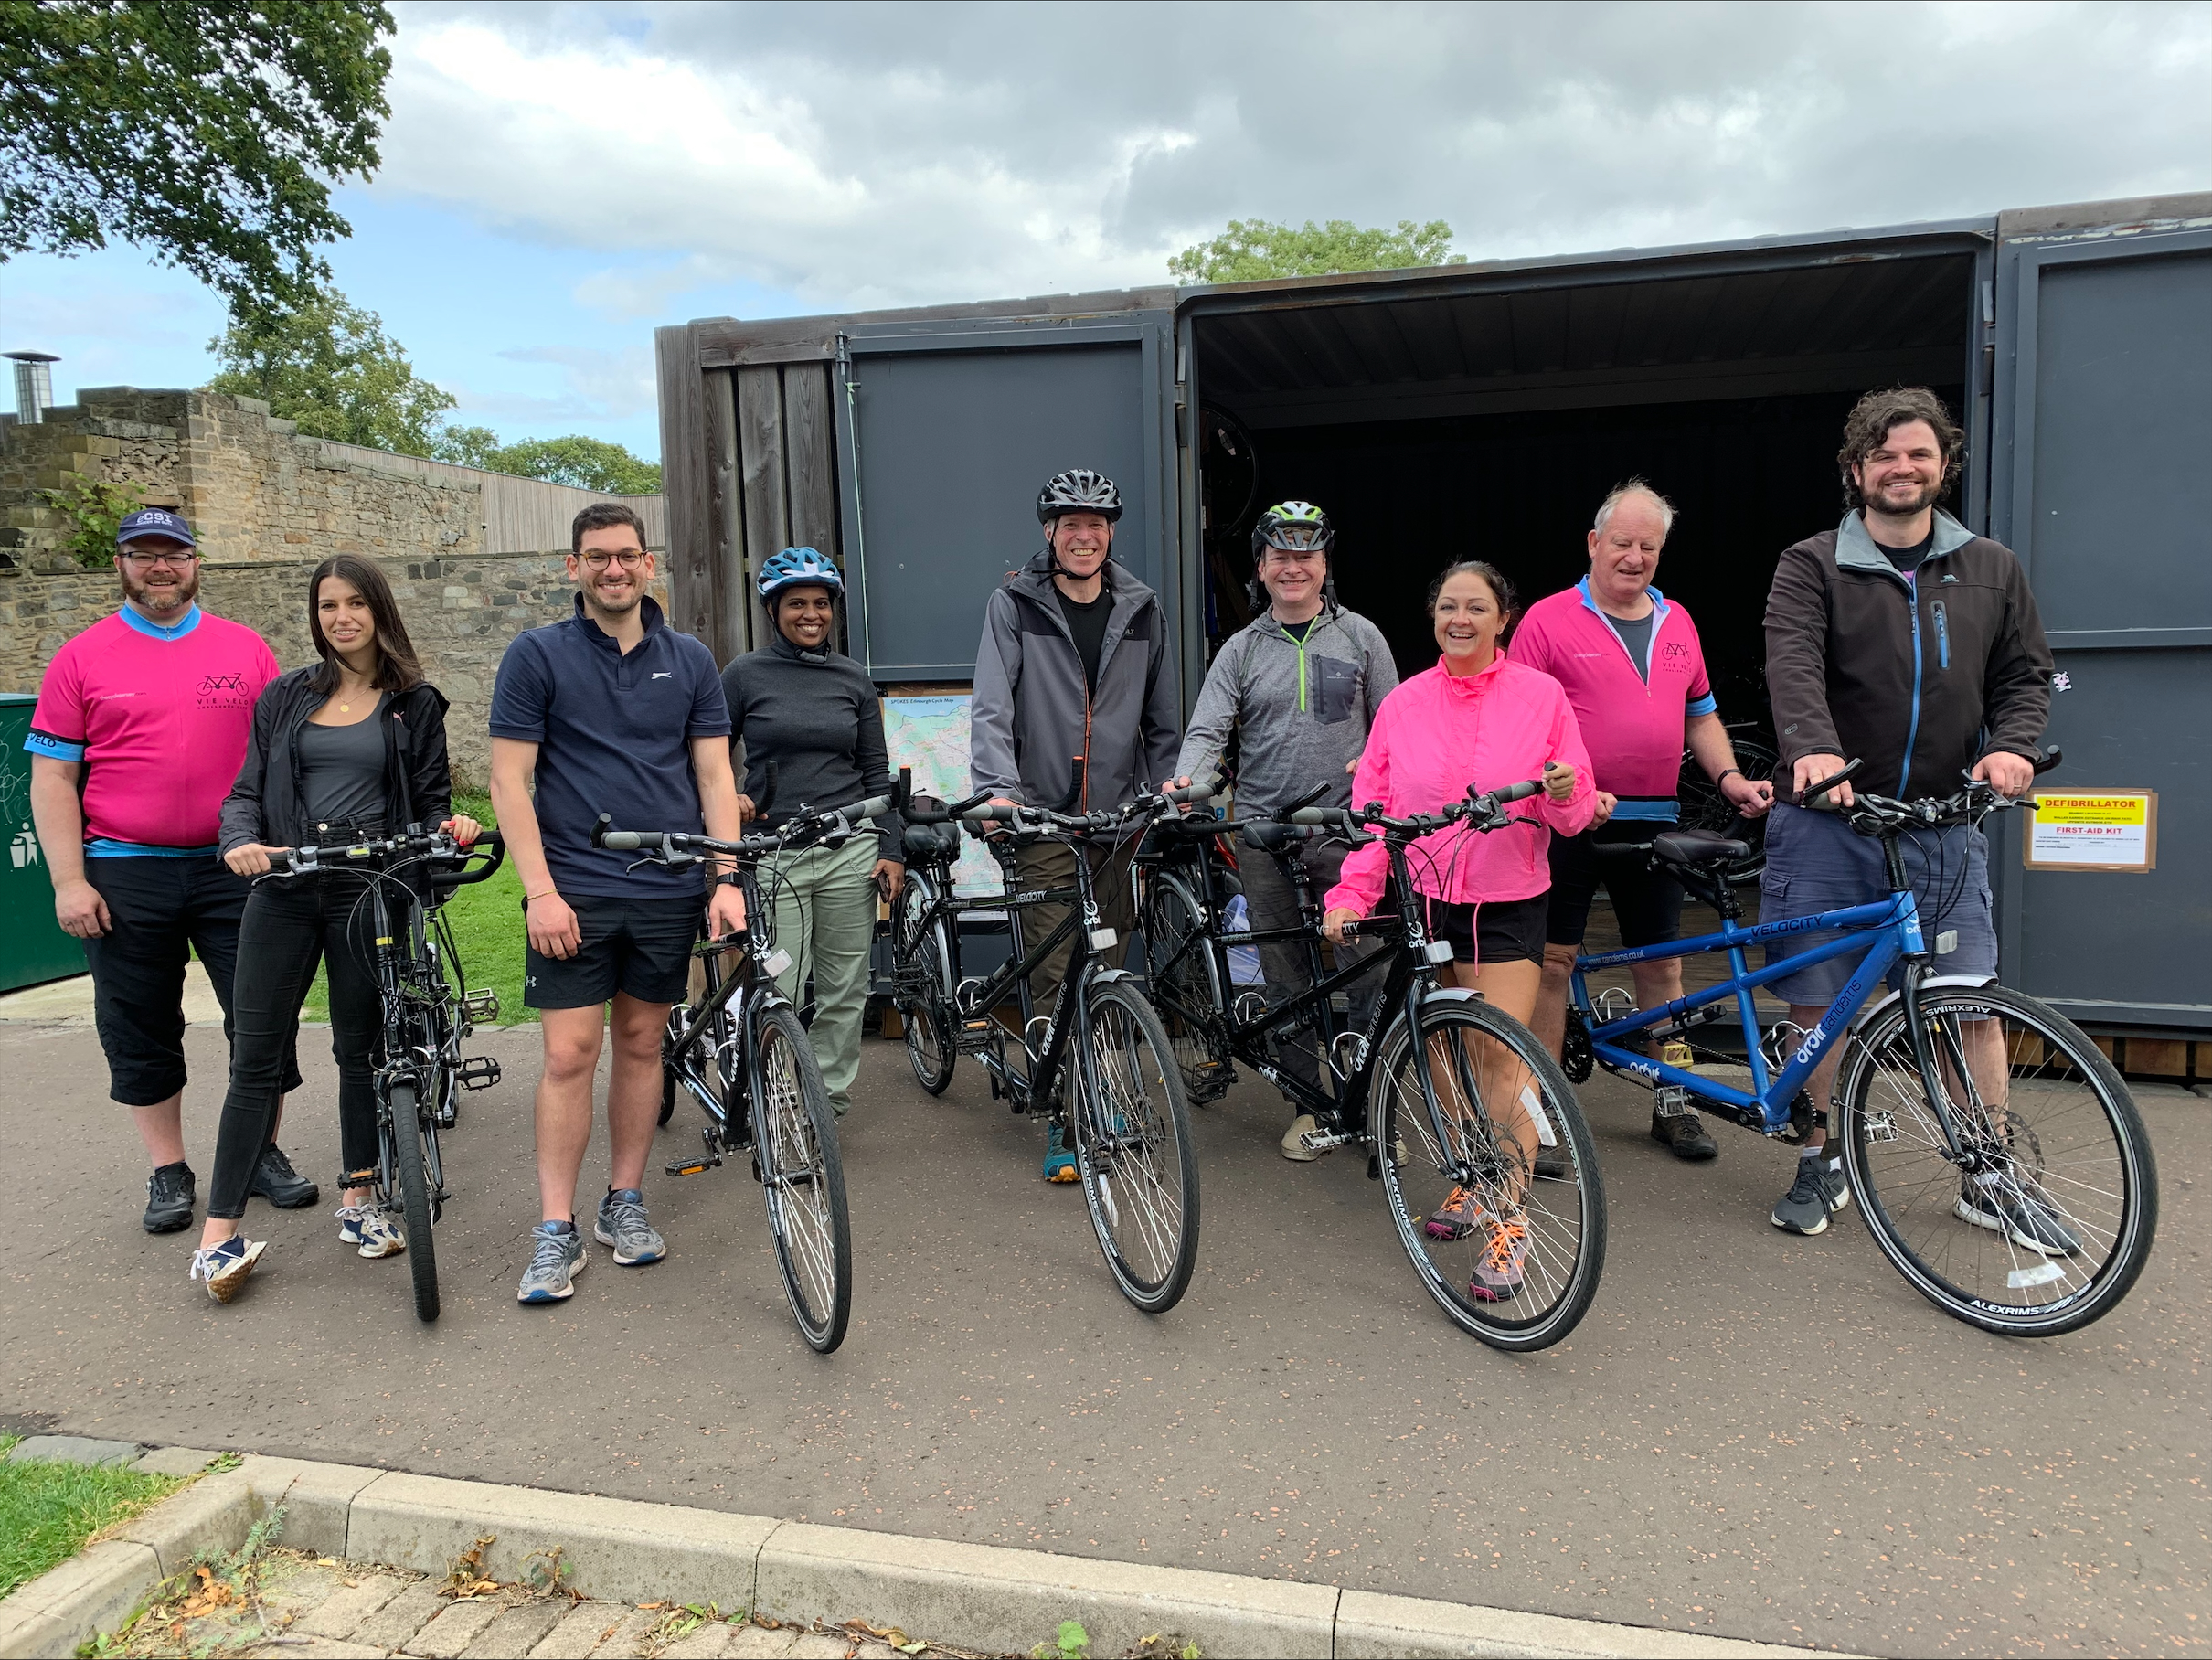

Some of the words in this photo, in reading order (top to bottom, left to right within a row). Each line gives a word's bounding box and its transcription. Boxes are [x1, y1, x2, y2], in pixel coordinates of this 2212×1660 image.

[225, 697, 249, 706] VELO
[2045, 799, 2136, 808] DEFIBRILLATOR
[1016, 890, 1048, 904] VELOCITY
[1749, 914, 1824, 938] VELOCITY
[1587, 949, 1646, 965] www.tandems.co.uk
[1821, 979, 1862, 1031] tandems
[1925, 1004, 1991, 1016] ALEXRIMS
[1630, 1061, 1660, 1082] orbit
[1081, 1144, 1099, 1210] ALEXRIMS
[1387, 1157, 1411, 1229] ALEXRIMS
[1970, 1299, 2040, 1315] ALEXRIMS
